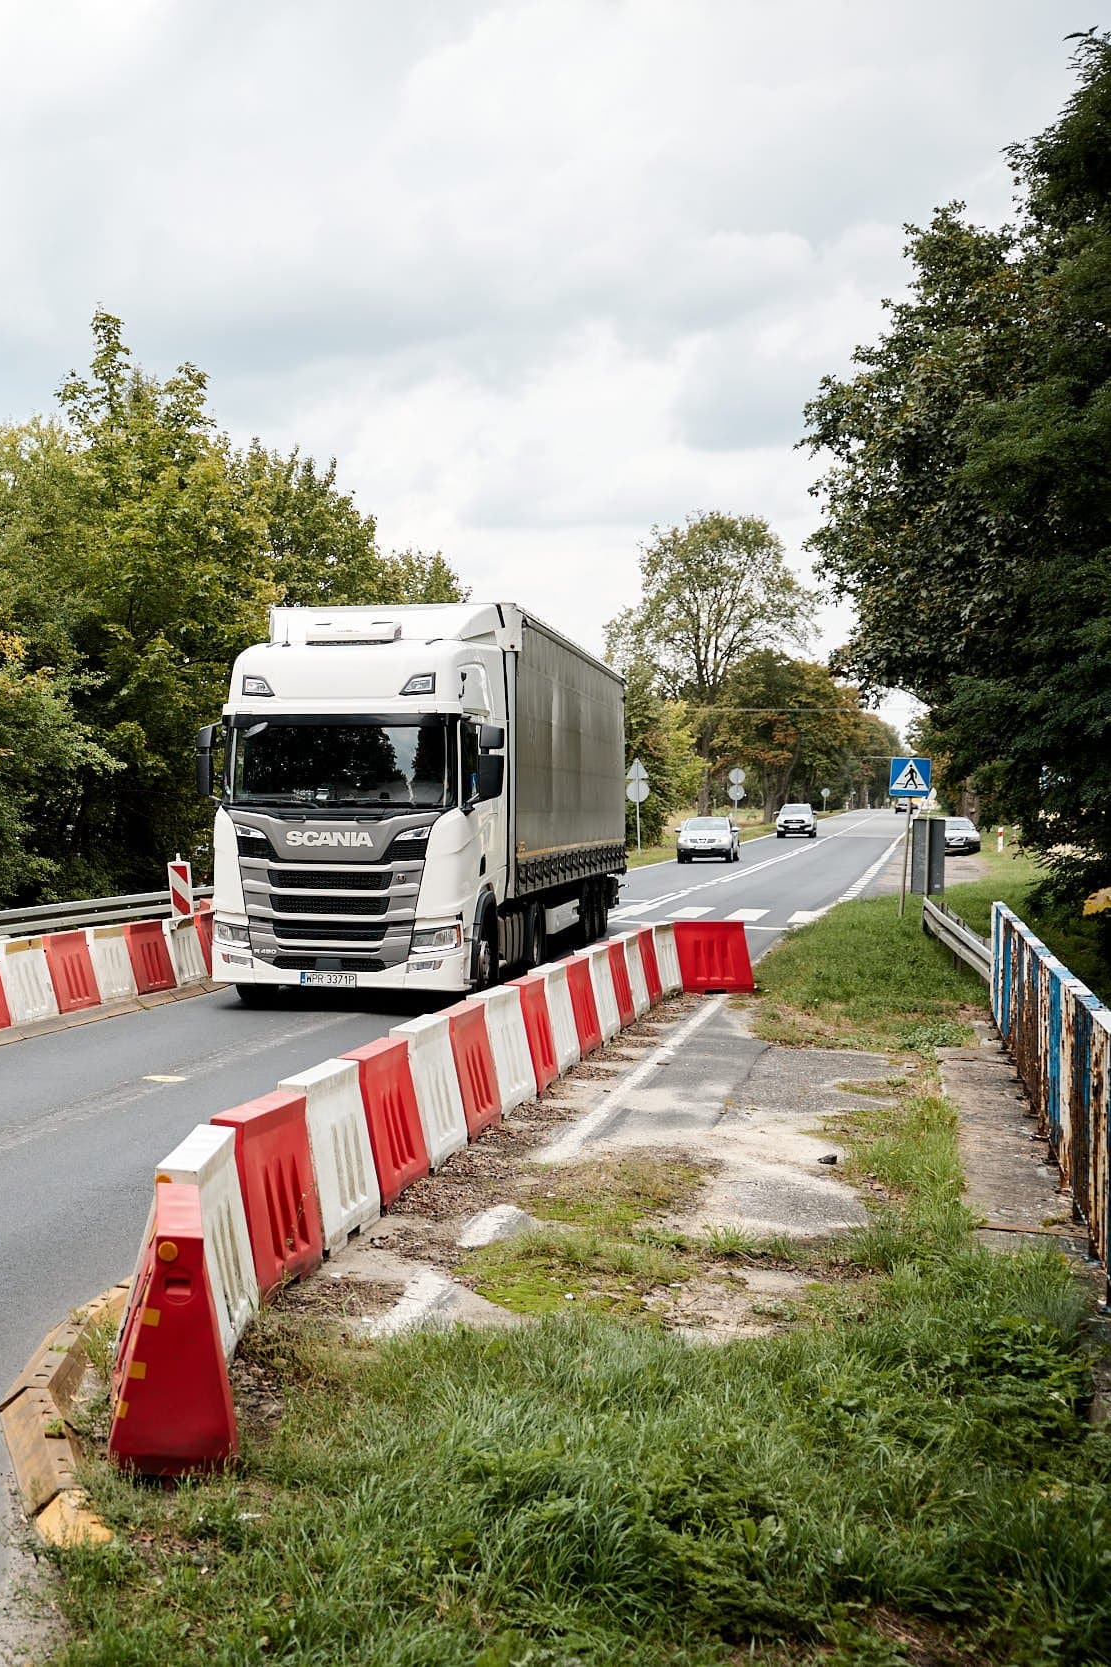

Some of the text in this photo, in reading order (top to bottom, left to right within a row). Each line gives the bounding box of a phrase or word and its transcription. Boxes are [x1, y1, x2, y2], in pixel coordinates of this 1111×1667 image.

[286, 831, 373, 847] SCANIA
[306, 973, 355, 985] WPR 3371P
